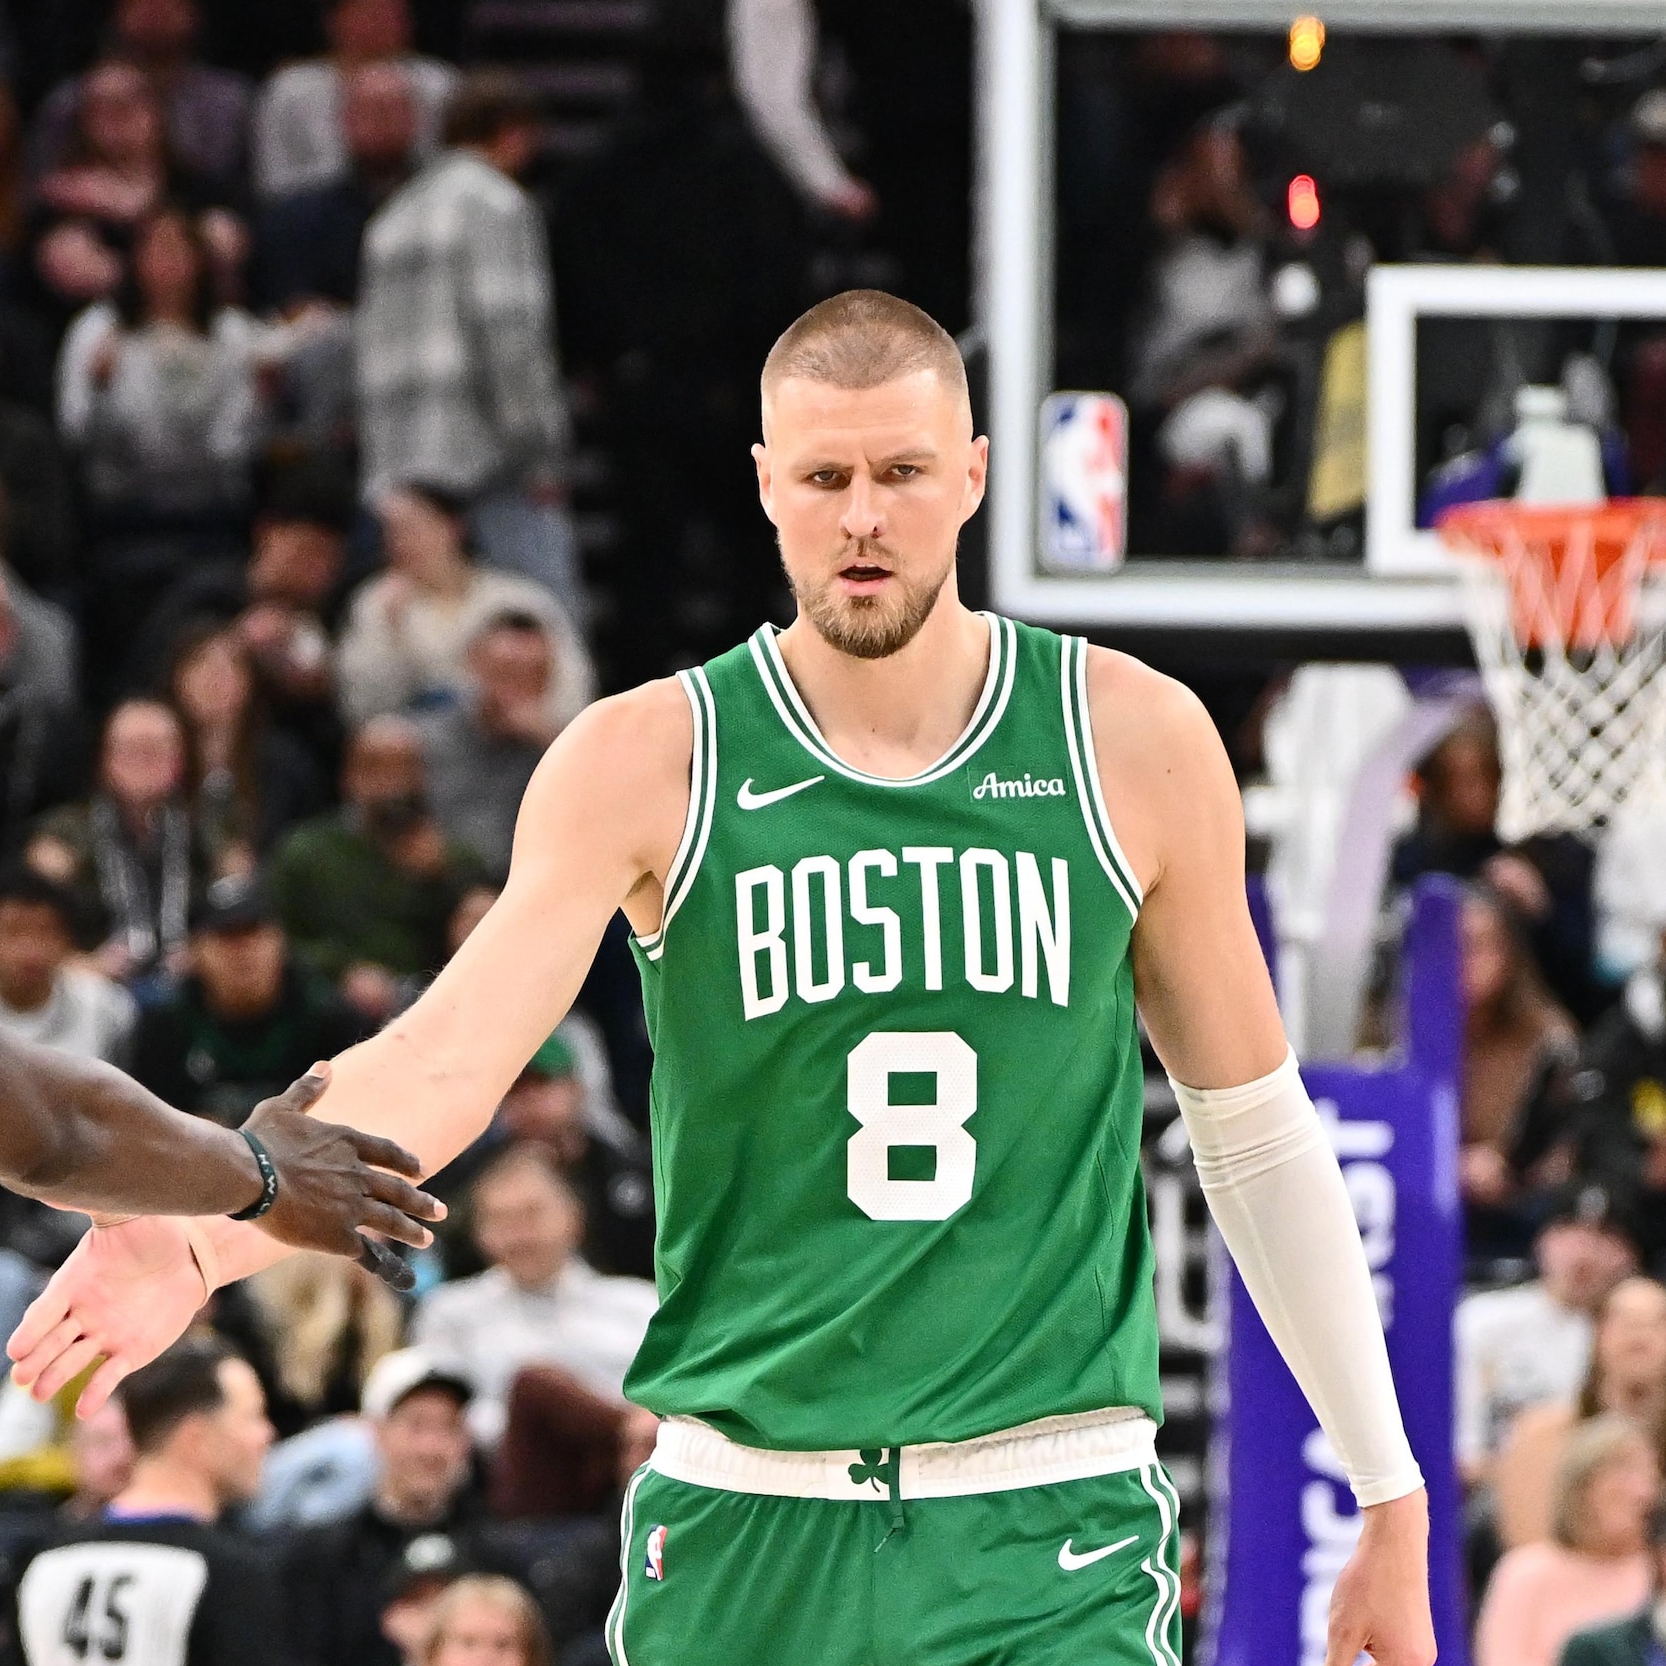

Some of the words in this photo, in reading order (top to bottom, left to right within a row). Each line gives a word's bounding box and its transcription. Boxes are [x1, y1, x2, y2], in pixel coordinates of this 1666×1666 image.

[970, 771, 1068, 802] Amica
[734, 845, 1071, 1021] BOSTON
[845, 1030, 978, 1221] 8
[63, 1571, 139, 1661] 45
